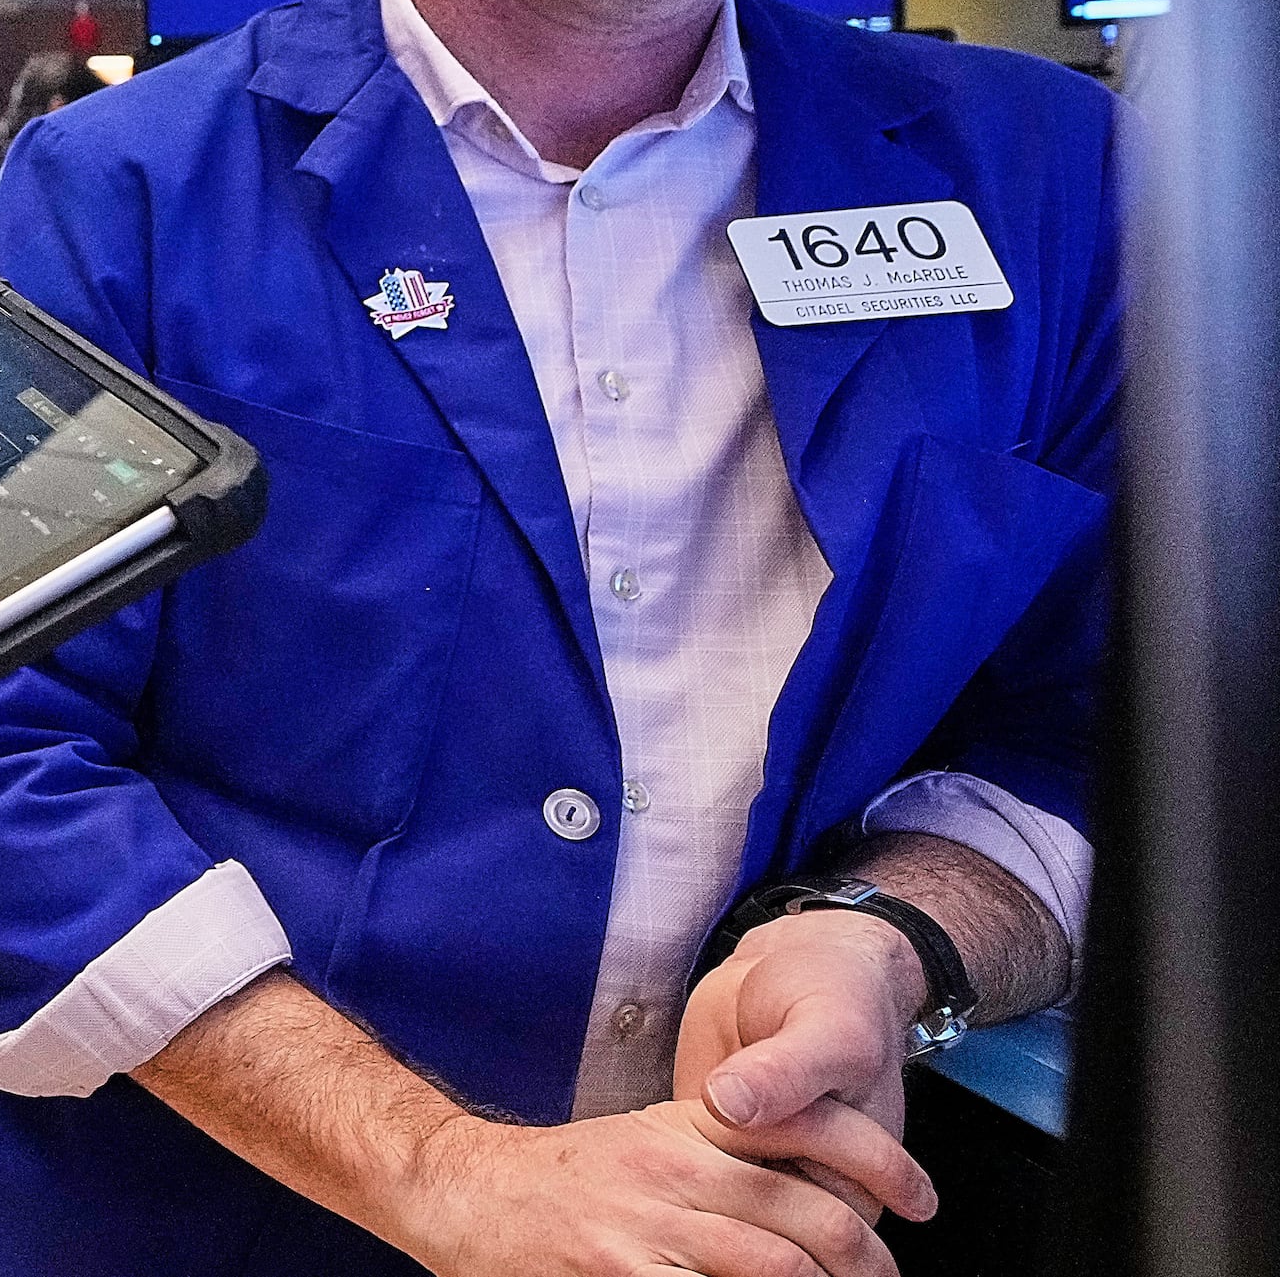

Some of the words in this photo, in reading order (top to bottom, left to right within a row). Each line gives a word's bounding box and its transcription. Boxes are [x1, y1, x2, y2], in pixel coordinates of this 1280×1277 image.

[767, 215, 948, 271] 1640
[781, 274, 853, 294] THOMAS
[862, 273, 880, 289] J.
[886, 265, 969, 285] McARDLE
[795, 301, 855, 319] CITADEL
[861, 295, 944, 313] SECURITIES
[950, 292, 979, 306] LLC
